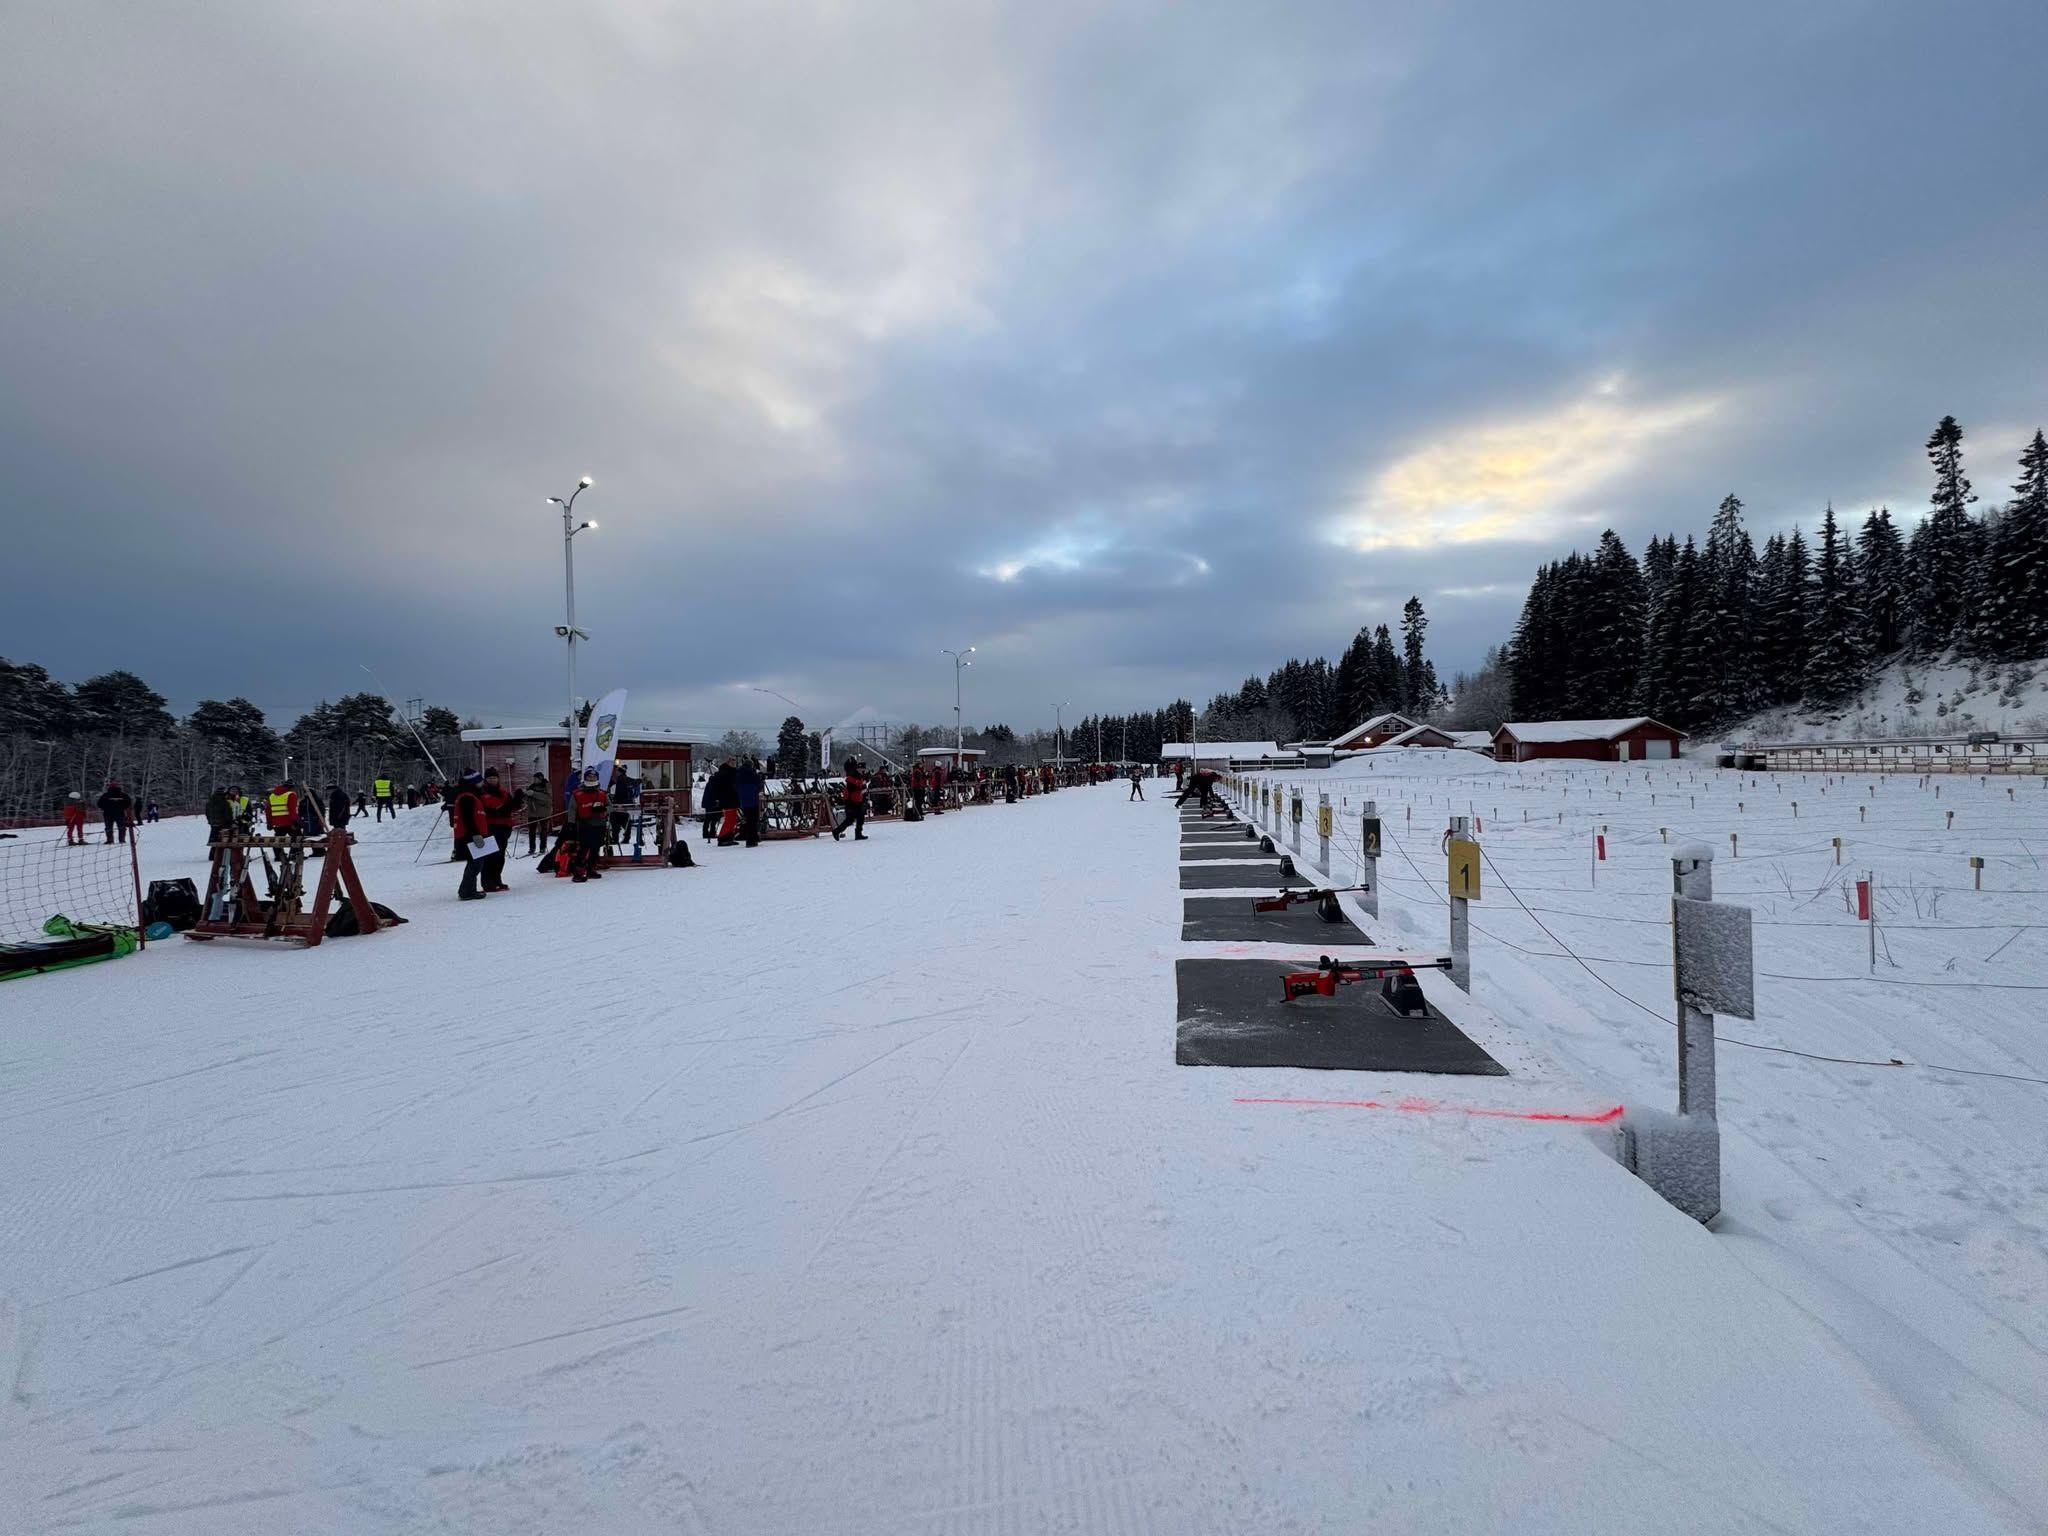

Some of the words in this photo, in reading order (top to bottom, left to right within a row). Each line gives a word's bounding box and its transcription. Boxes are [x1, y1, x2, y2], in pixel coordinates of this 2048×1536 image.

[1323, 817, 1329, 833] 3
[1367, 832, 1377, 852] 2
[1460, 863, 1469, 893] 1
